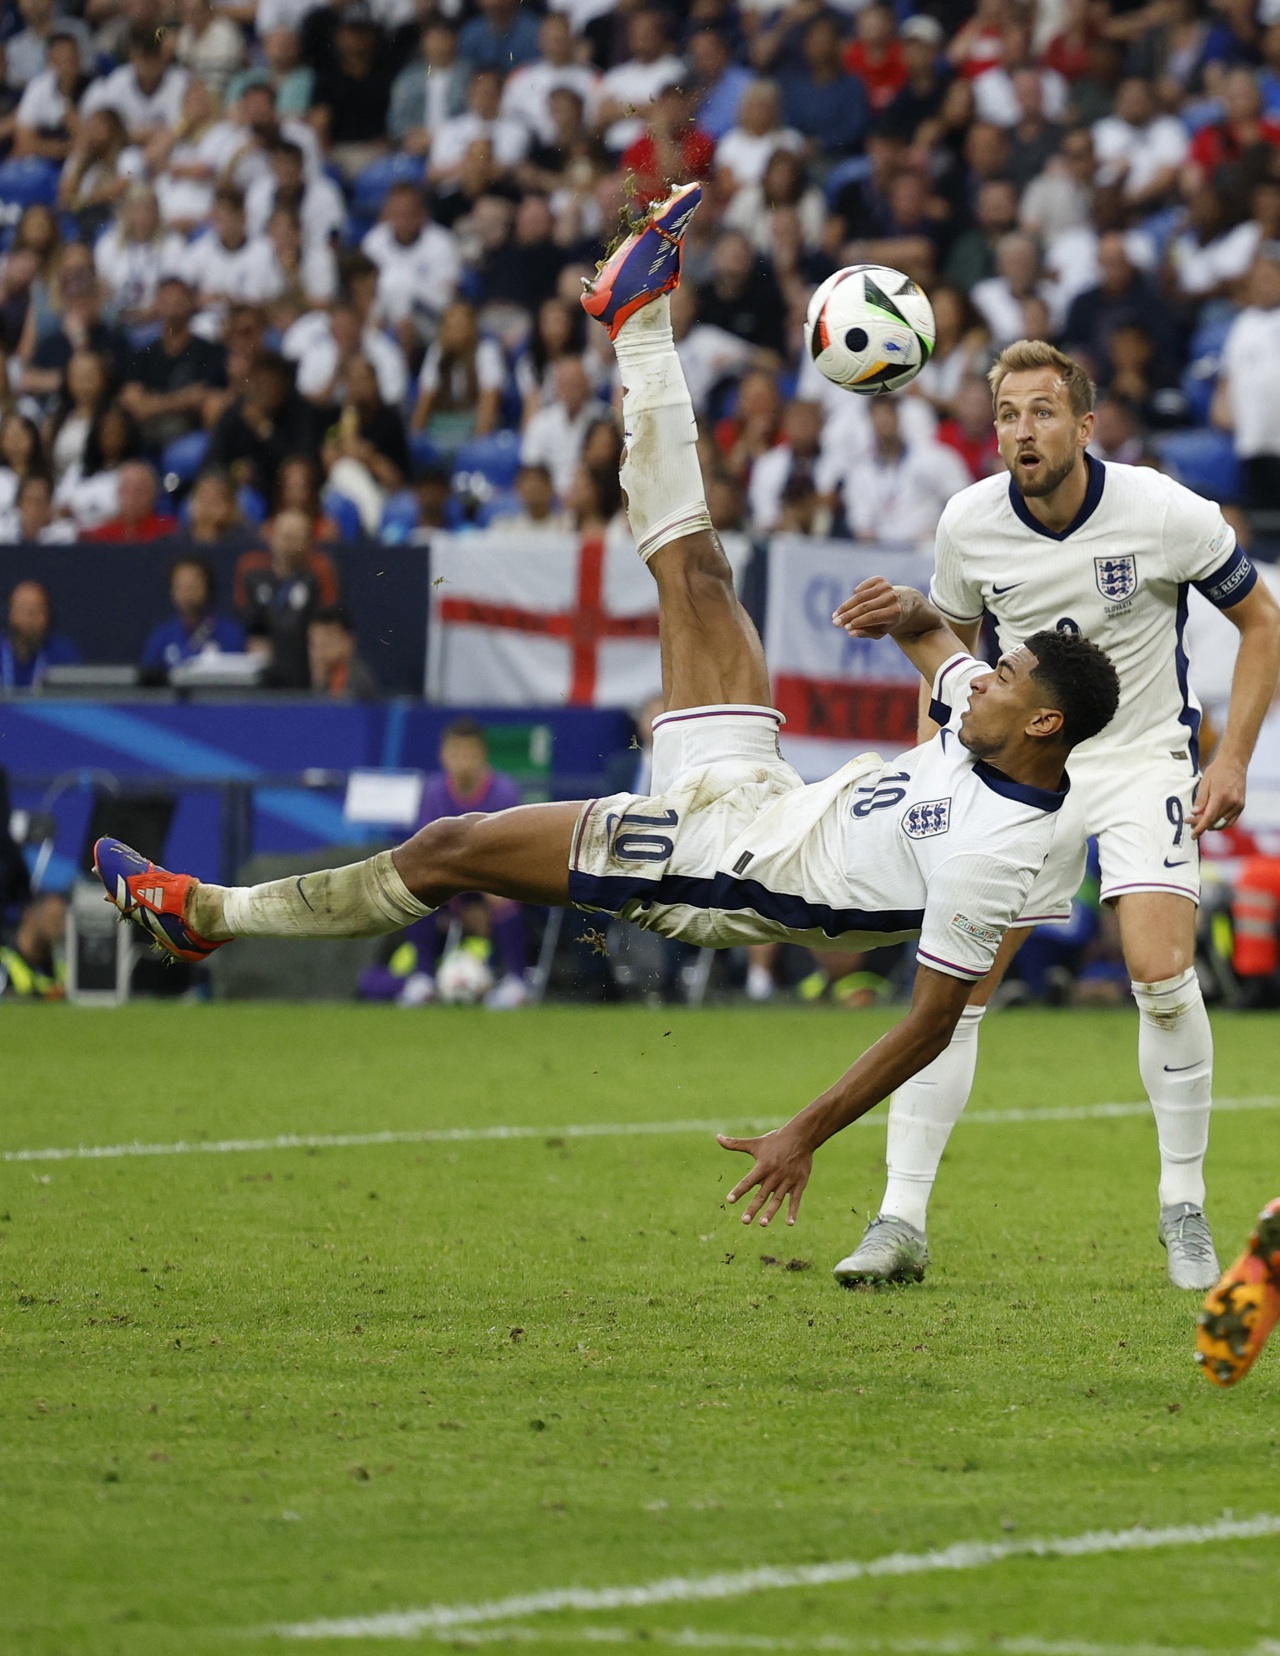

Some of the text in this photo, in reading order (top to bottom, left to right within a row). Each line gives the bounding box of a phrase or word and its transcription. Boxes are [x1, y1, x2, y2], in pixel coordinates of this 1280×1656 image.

[1221, 558, 1249, 593] RESPECT
[850, 771, 911, 820] 10
[614, 808, 679, 863] 10
[1165, 795, 1184, 849] 9
